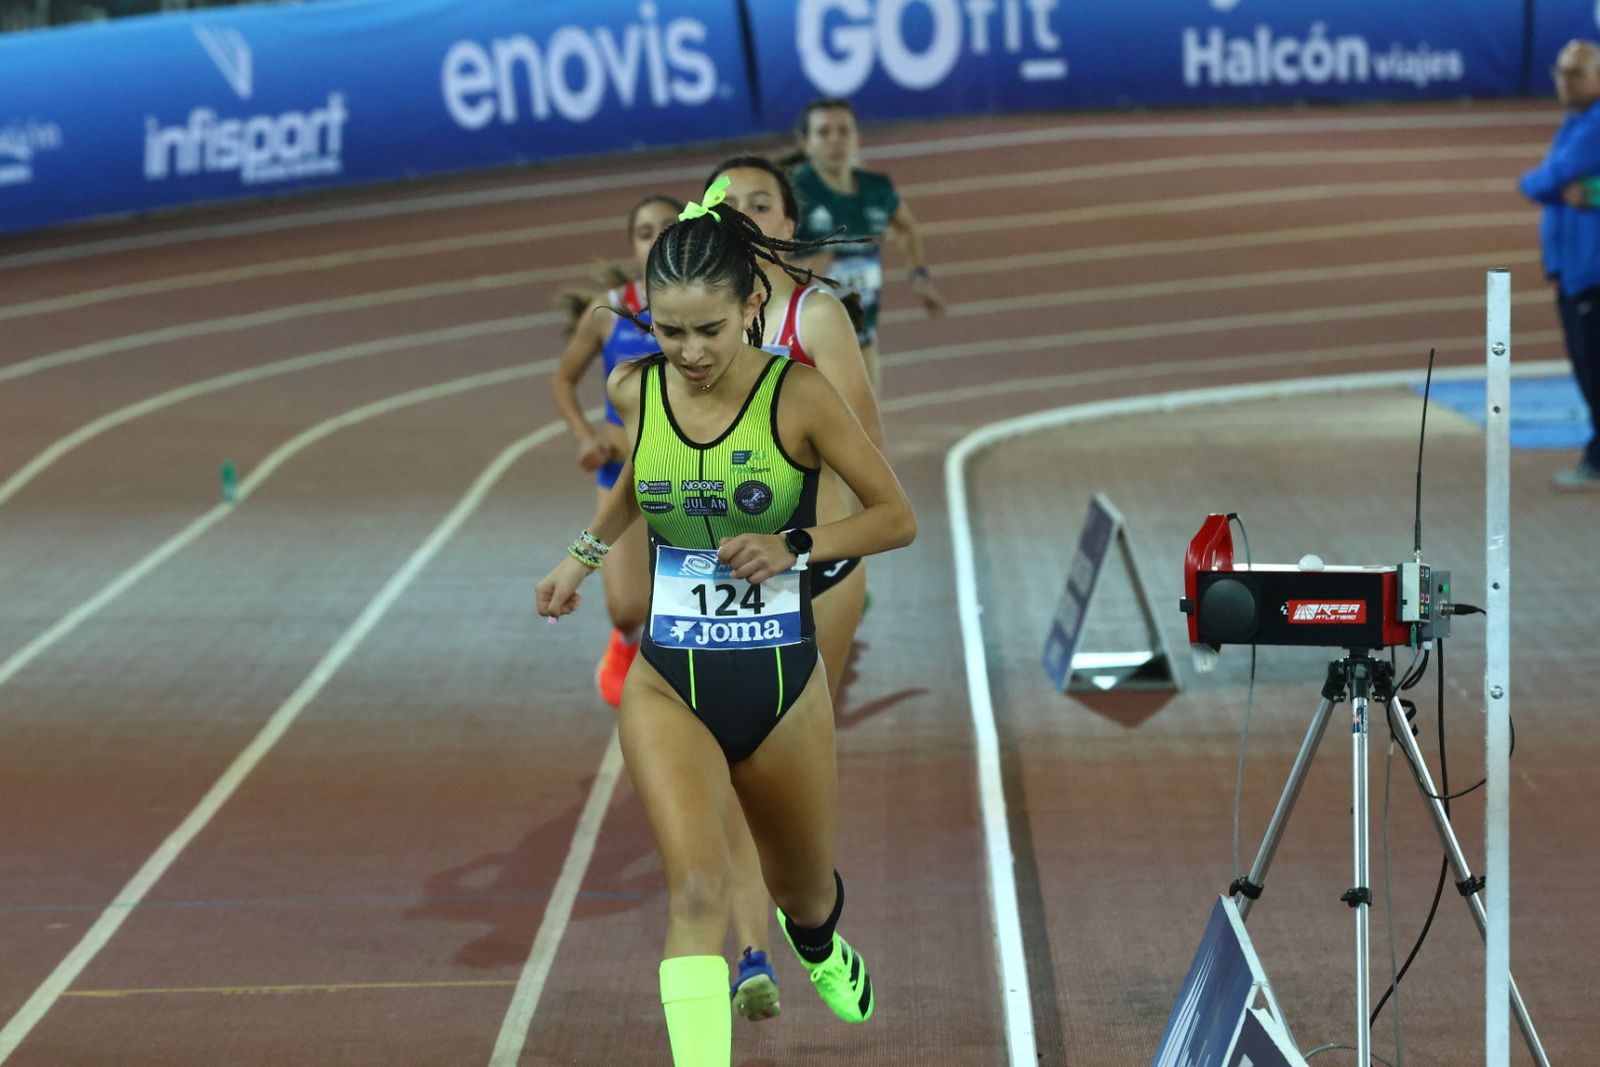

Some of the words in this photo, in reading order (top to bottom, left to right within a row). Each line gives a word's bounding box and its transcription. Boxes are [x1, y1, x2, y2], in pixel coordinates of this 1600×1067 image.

[441, 1, 717, 129] enovis
[1182, 20, 1370, 87] Halcón
[1373, 42, 1464, 86] viajes
[682, 481, 724, 491] NOONE
[691, 583, 765, 616] 124
